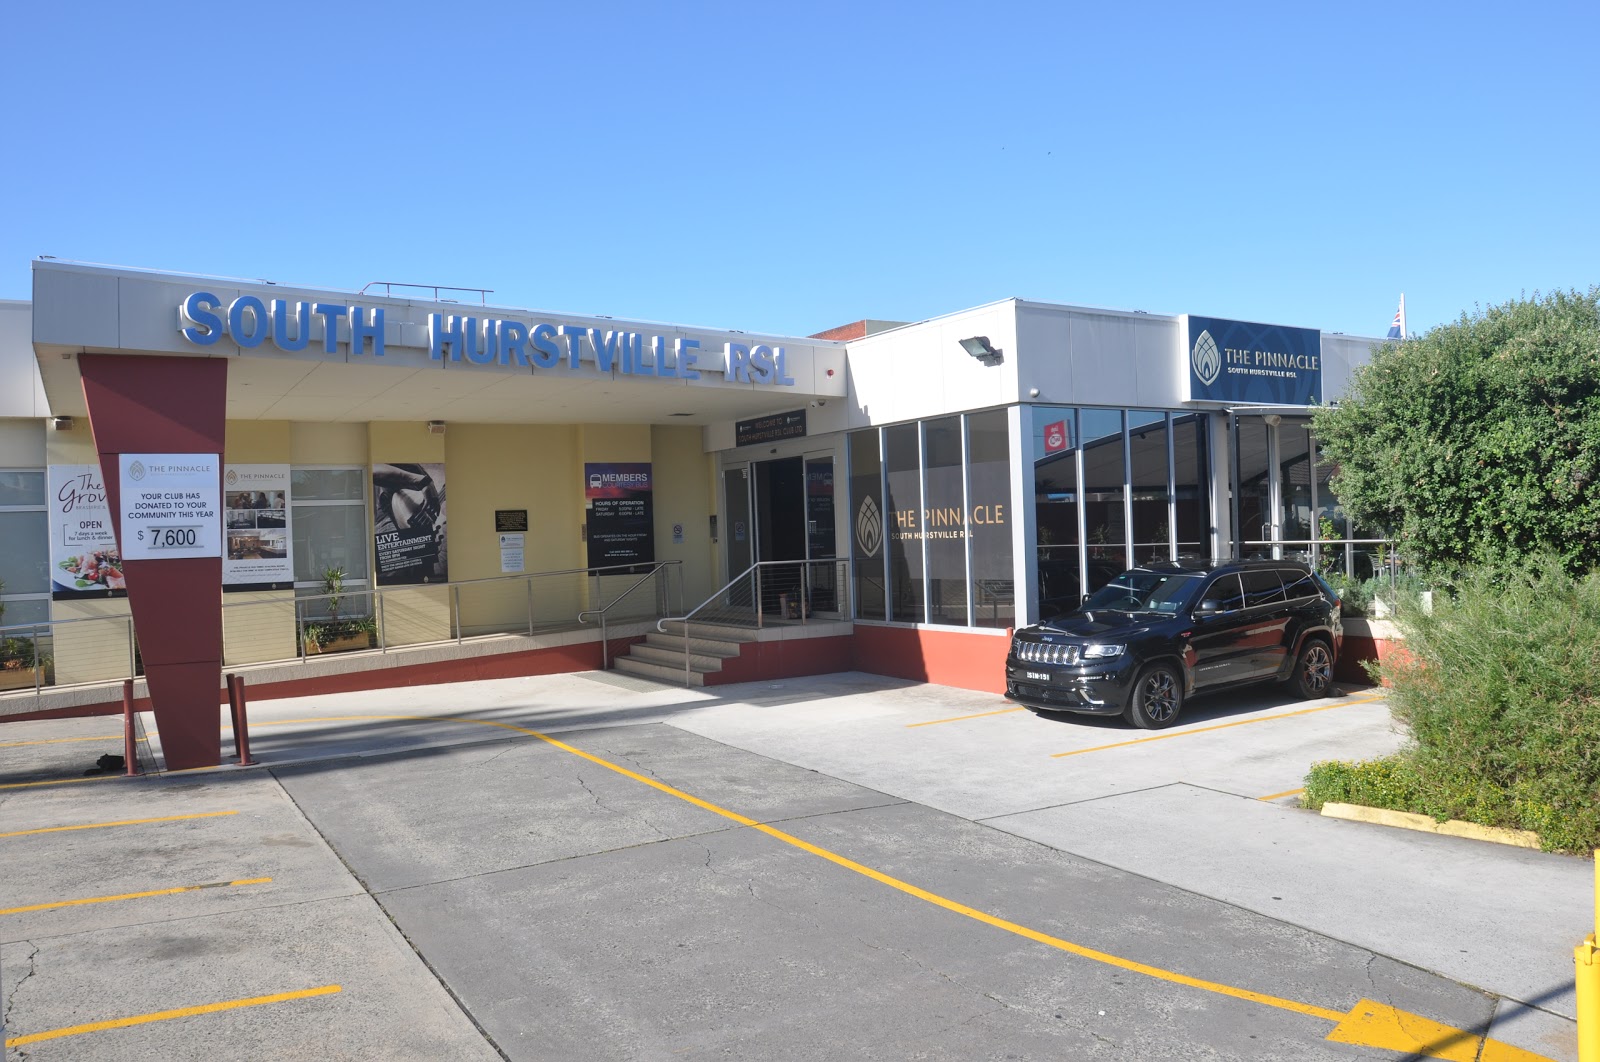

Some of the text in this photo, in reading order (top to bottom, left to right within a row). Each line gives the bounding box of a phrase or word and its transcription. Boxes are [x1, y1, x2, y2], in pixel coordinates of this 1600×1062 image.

[182, 291, 795, 387] SOUTH HURSTVILLE RSL
[1225, 348, 1319, 370] THE PINNACLE
[1227, 366, 1297, 379] SOUTH HURSTVILLE RSL
[77, 473, 104, 490] The
[602, 473, 648, 482] MEMBERS
[602, 481, 635, 489] COURTESY
[58, 479, 106, 513] Grov
[185, 492, 201, 500] HAS
[135, 502, 172, 510] DONATED
[128, 511, 177, 519] COMMUNITY
[889, 510, 916, 528] THE
[79, 520, 103, 529] OPEN
[137, 528, 196, 548] $ 7,600
[375, 532, 400, 545] LIVE
[891, 532, 913, 540] SOUTH
[959, 530, 974, 539] RL
[377, 534, 432, 551] ENTERTAINMENT
